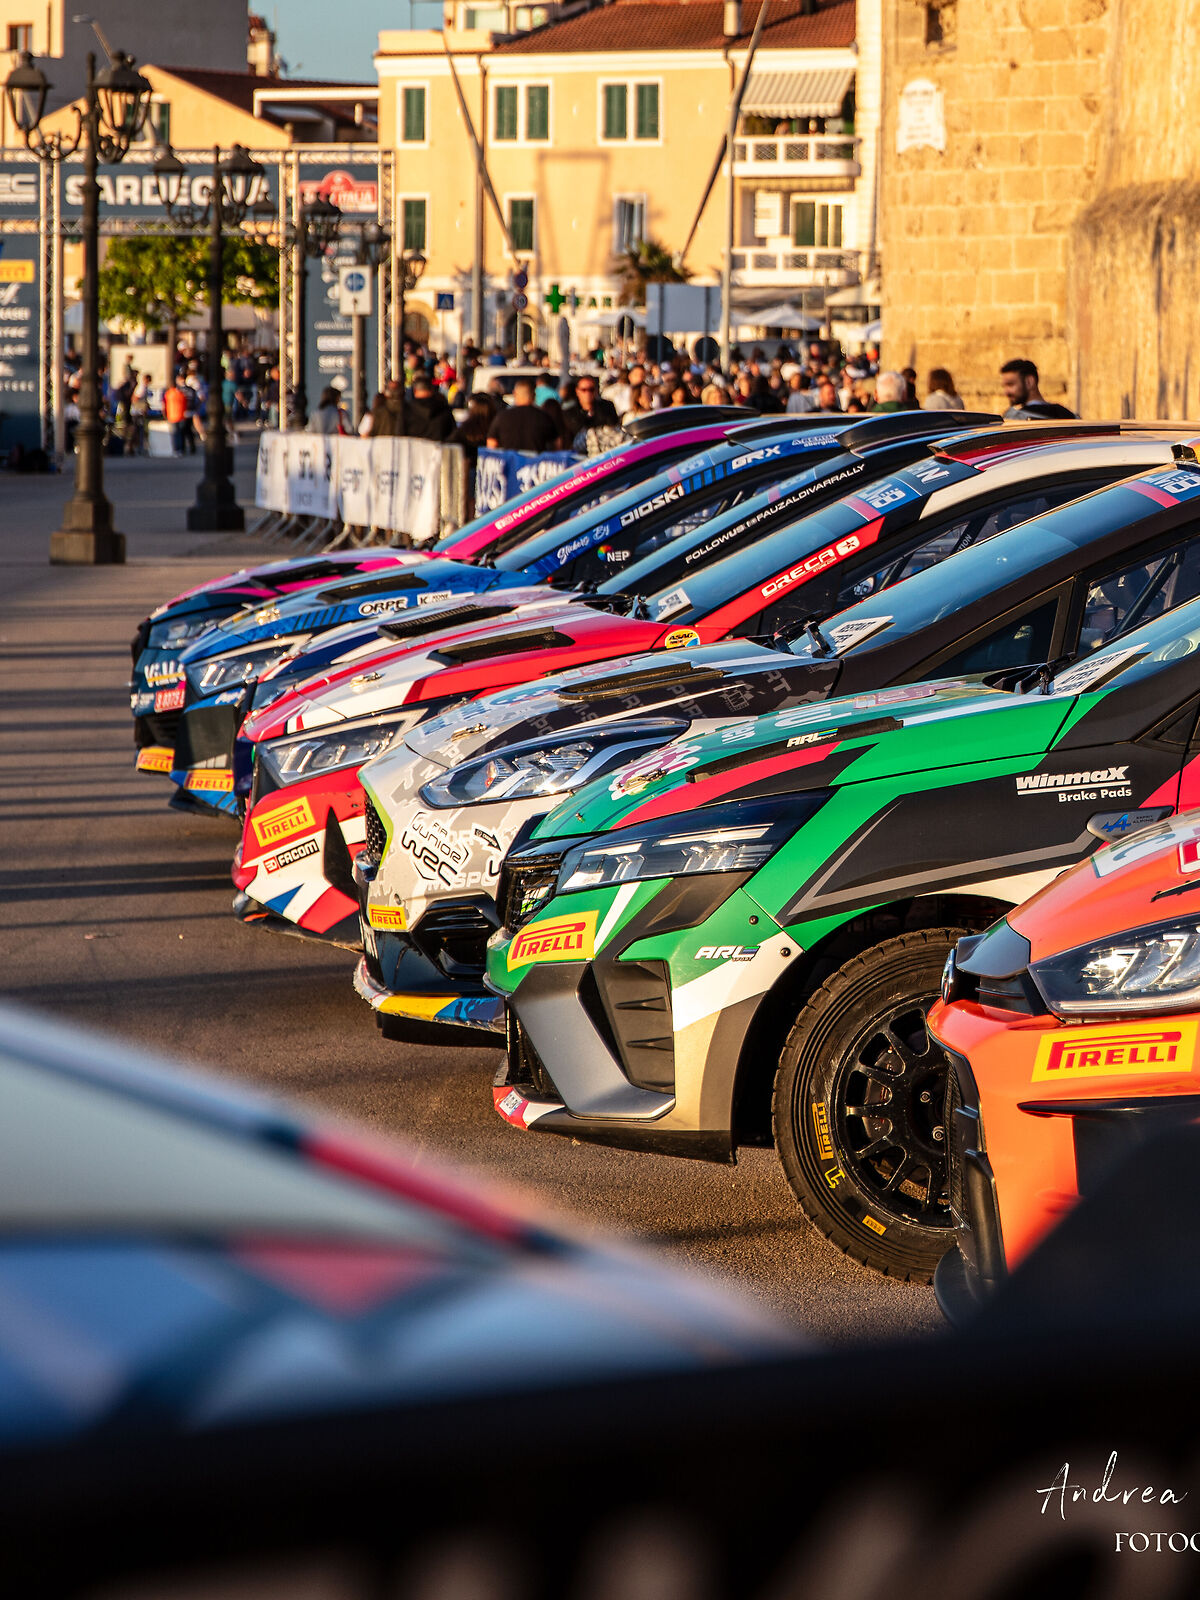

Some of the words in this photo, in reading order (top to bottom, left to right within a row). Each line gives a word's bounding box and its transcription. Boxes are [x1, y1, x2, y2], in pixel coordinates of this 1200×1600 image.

[732, 445, 781, 470] GRX
[761, 548, 835, 598] ORECA
[1058, 789, 1097, 803] Brake
[1100, 786, 1133, 800] Pads
[258, 805, 308, 840] PIRELLI
[278, 841, 318, 867] FACOM
[371, 908, 402, 925] PIRELLI
[511, 921, 586, 960] PIRELLI
[1046, 1031, 1182, 1071] PIRELLI
[812, 1102, 834, 1160] PIRELLI
